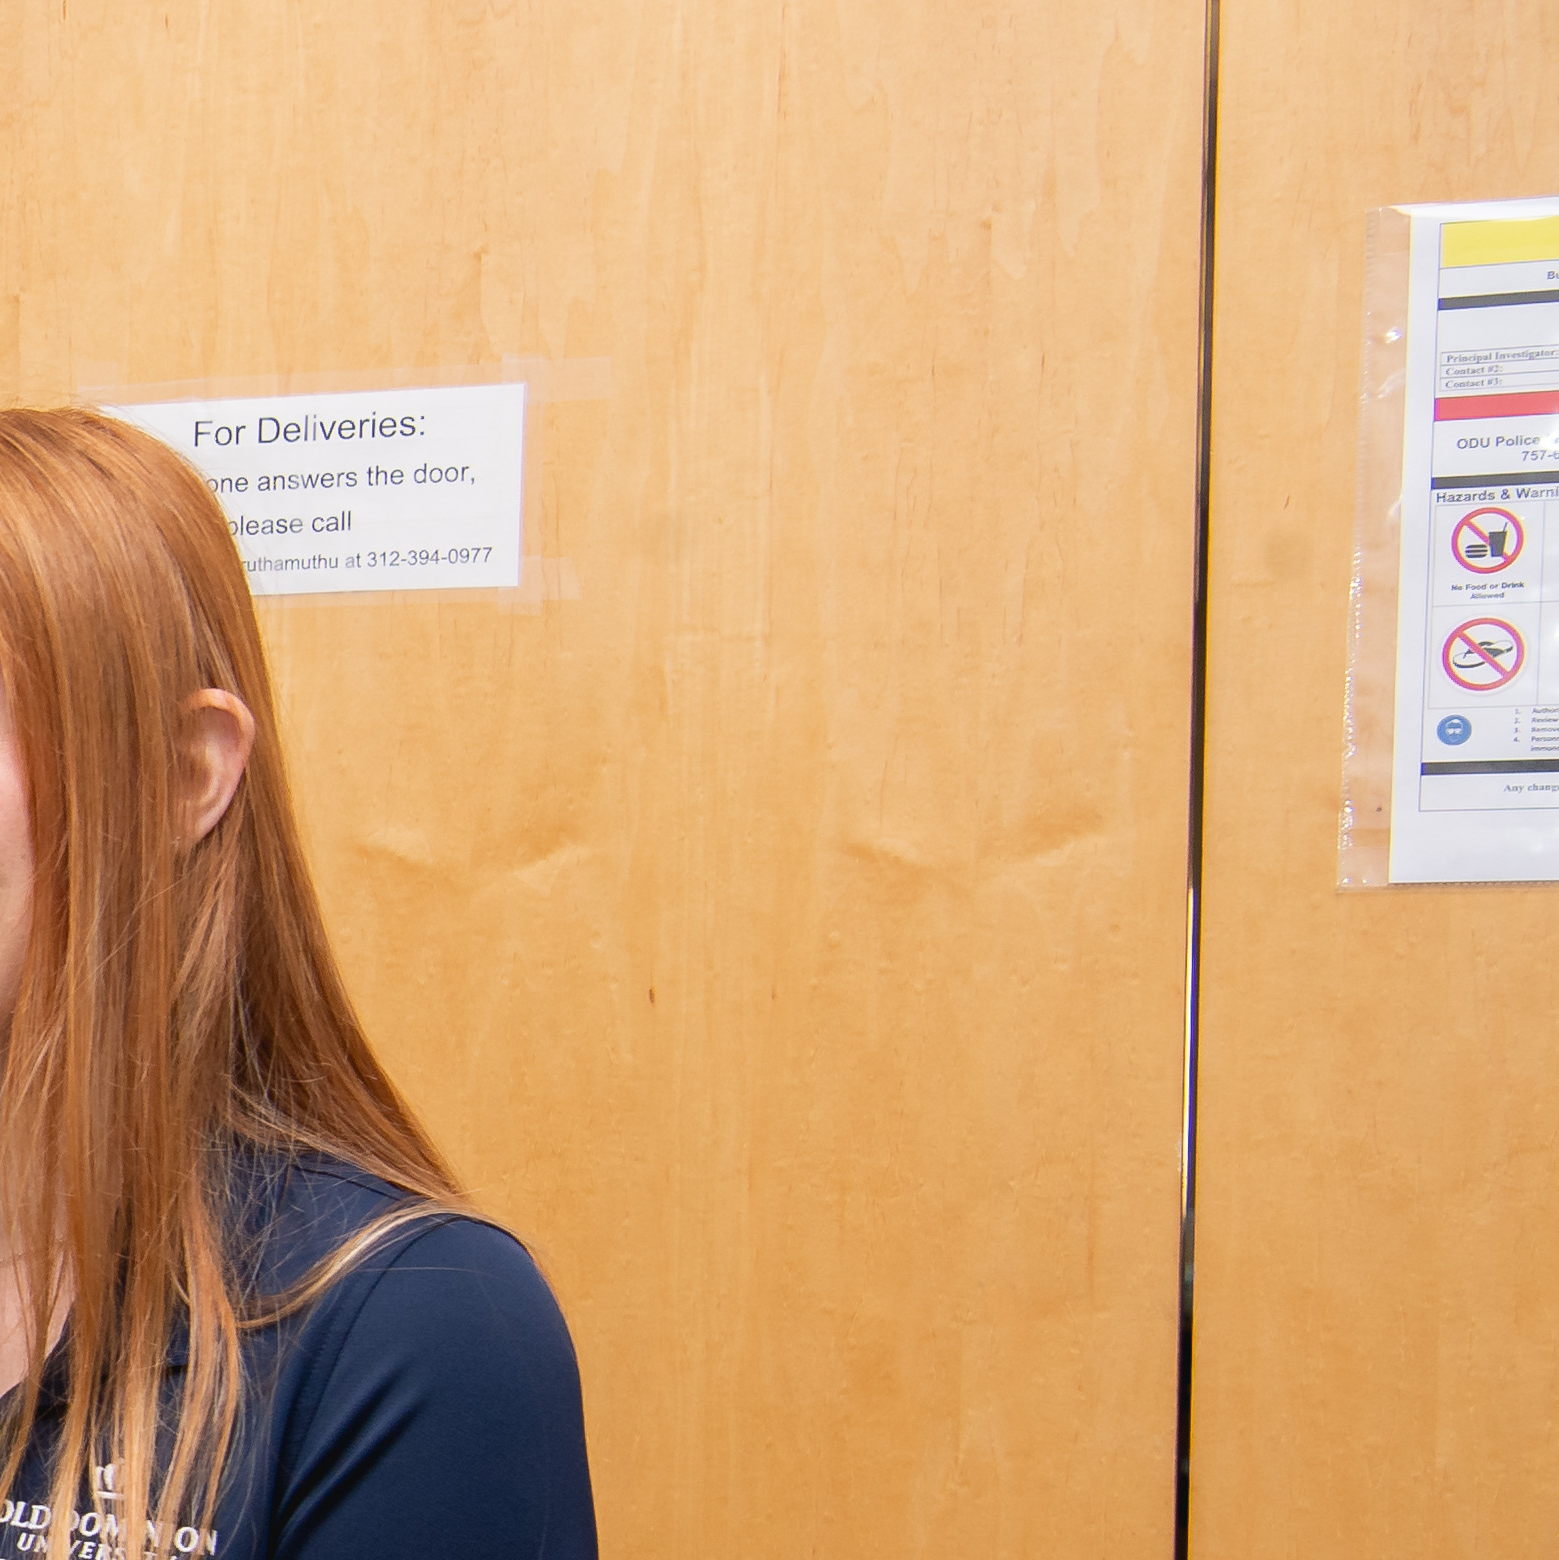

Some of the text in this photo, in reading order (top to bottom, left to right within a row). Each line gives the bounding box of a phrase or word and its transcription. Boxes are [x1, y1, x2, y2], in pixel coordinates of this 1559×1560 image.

[1446, 352, 1492, 364] Principal
[1445, 366, 1485, 376] Contact
[1445, 379, 1485, 388] Contact
[194, 411, 425, 447] For Deliveries:
[1456, 437, 1490, 449] ODU
[1495, 435, 1540, 447] Police
[258, 471, 358, 492] answers
[367, 465, 404, 486] the
[413, 463, 476, 485] door,
[1436, 490, 1495, 503] Hazards
[1501, 488, 1510, 500] &
[311, 510, 352, 532] call
[345, 553, 362, 569] at
[367, 547, 493, 567] 312-394-0977
[1465, 583, 1487, 591] Food
[1503, 784, 1524, 793] Any
